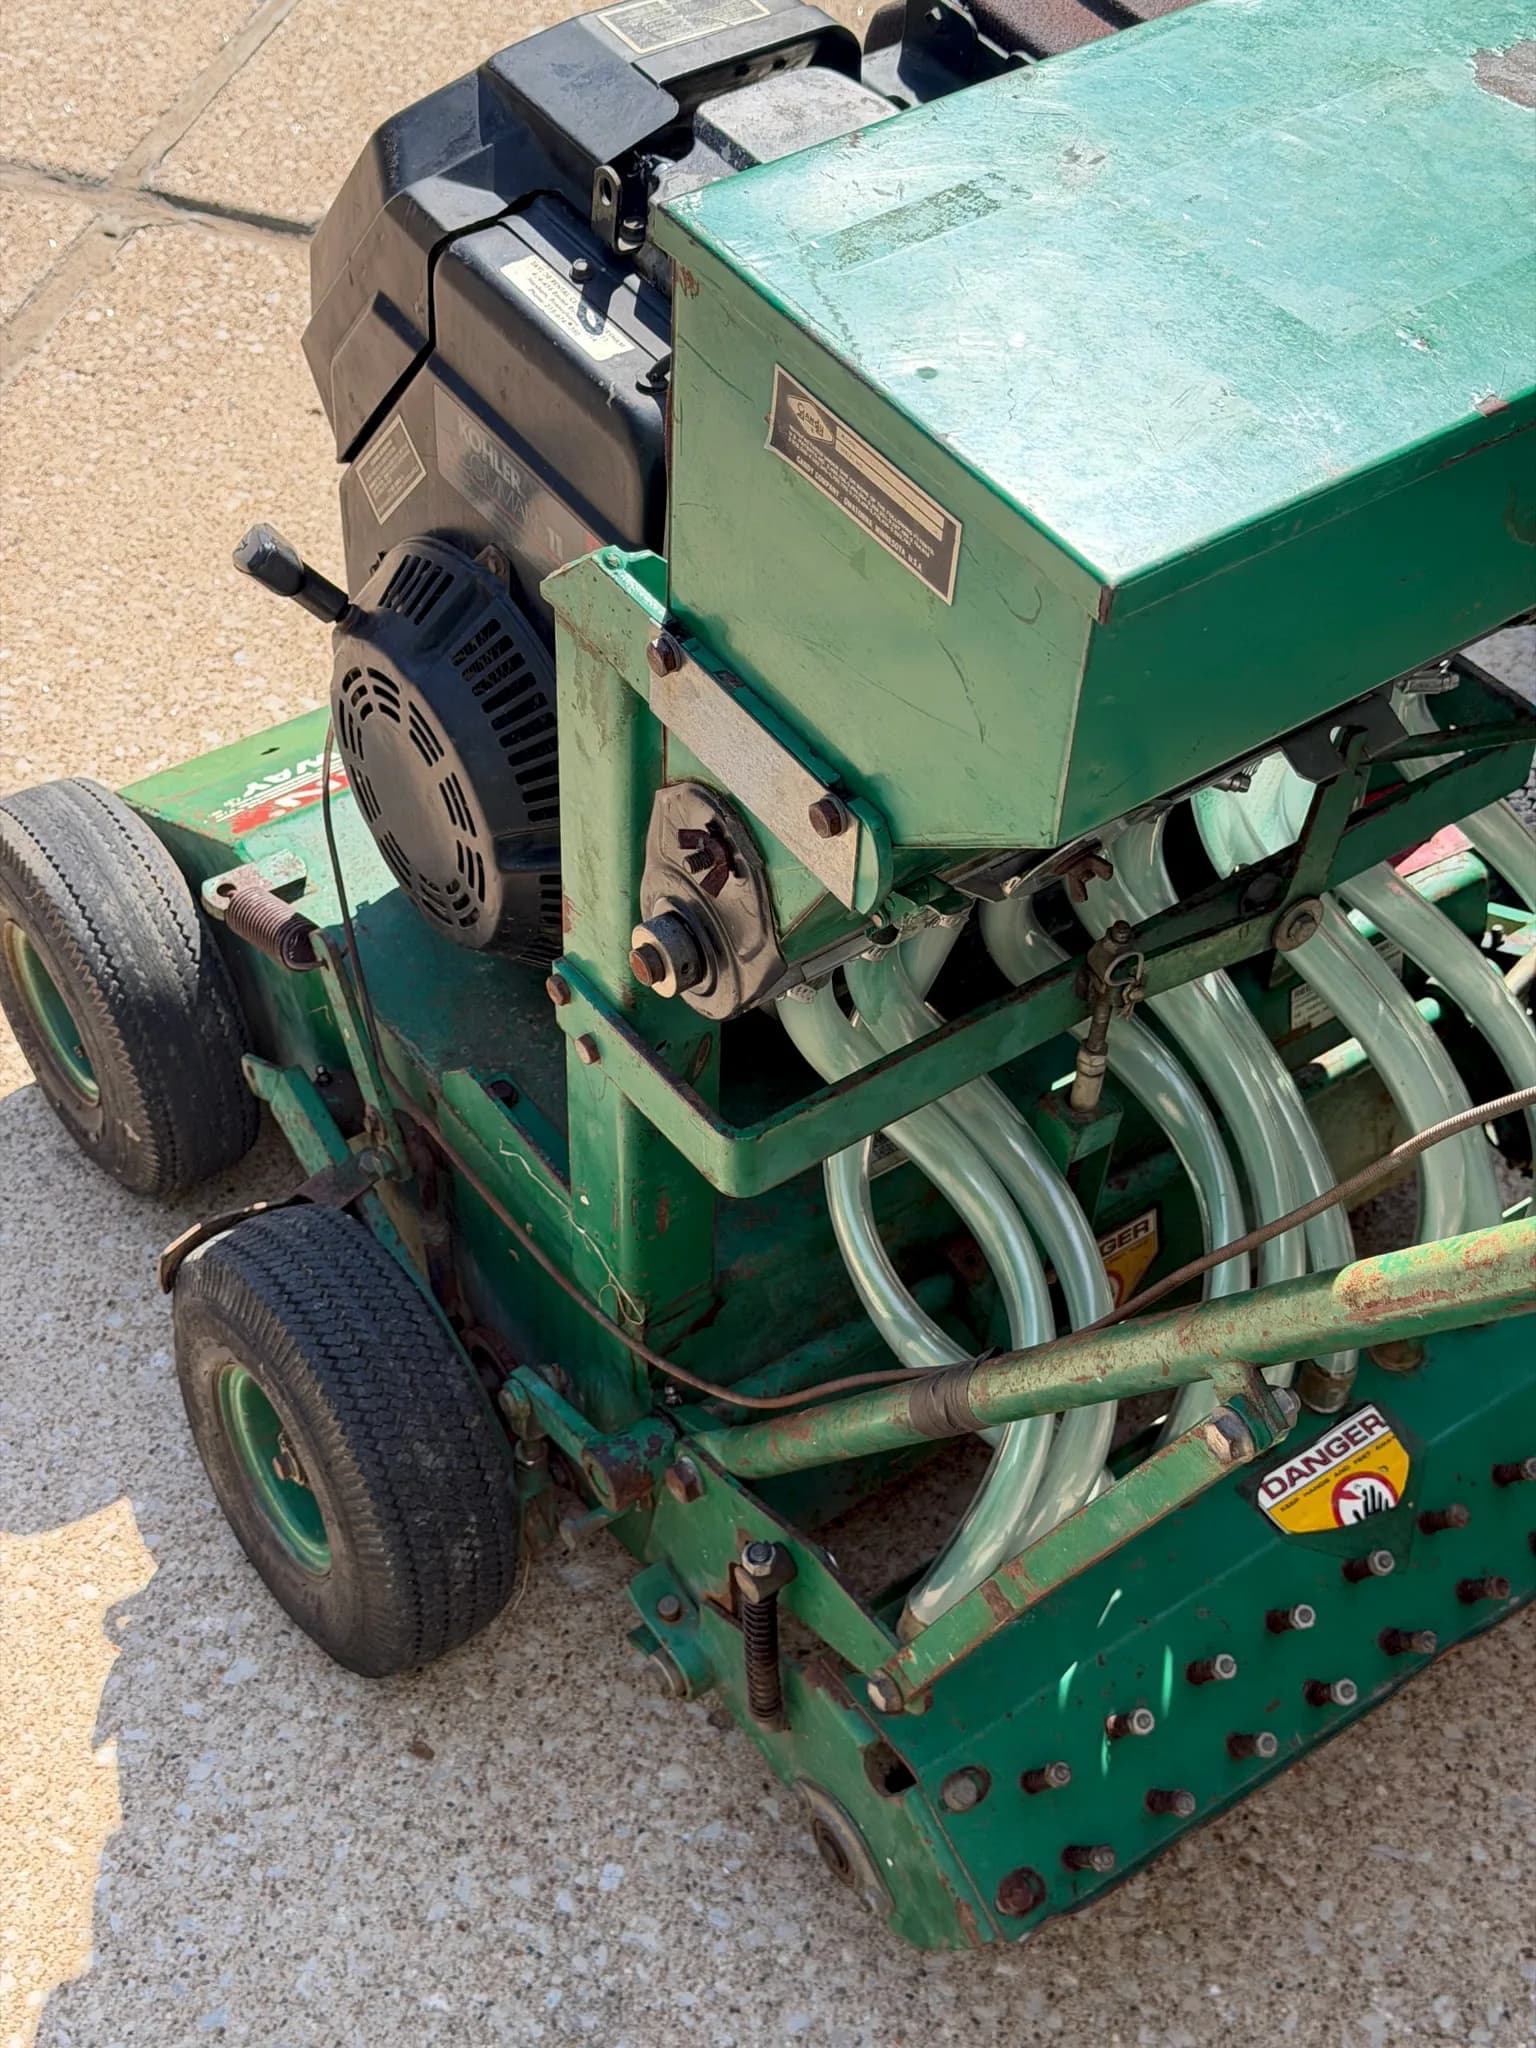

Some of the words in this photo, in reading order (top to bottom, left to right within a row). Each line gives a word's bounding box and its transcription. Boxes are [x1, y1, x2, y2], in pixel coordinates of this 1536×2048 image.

[458, 414, 522, 491] KOHLER
[1099, 1218, 1149, 1257] GER
[1260, 1413, 1387, 1500] DANGER
